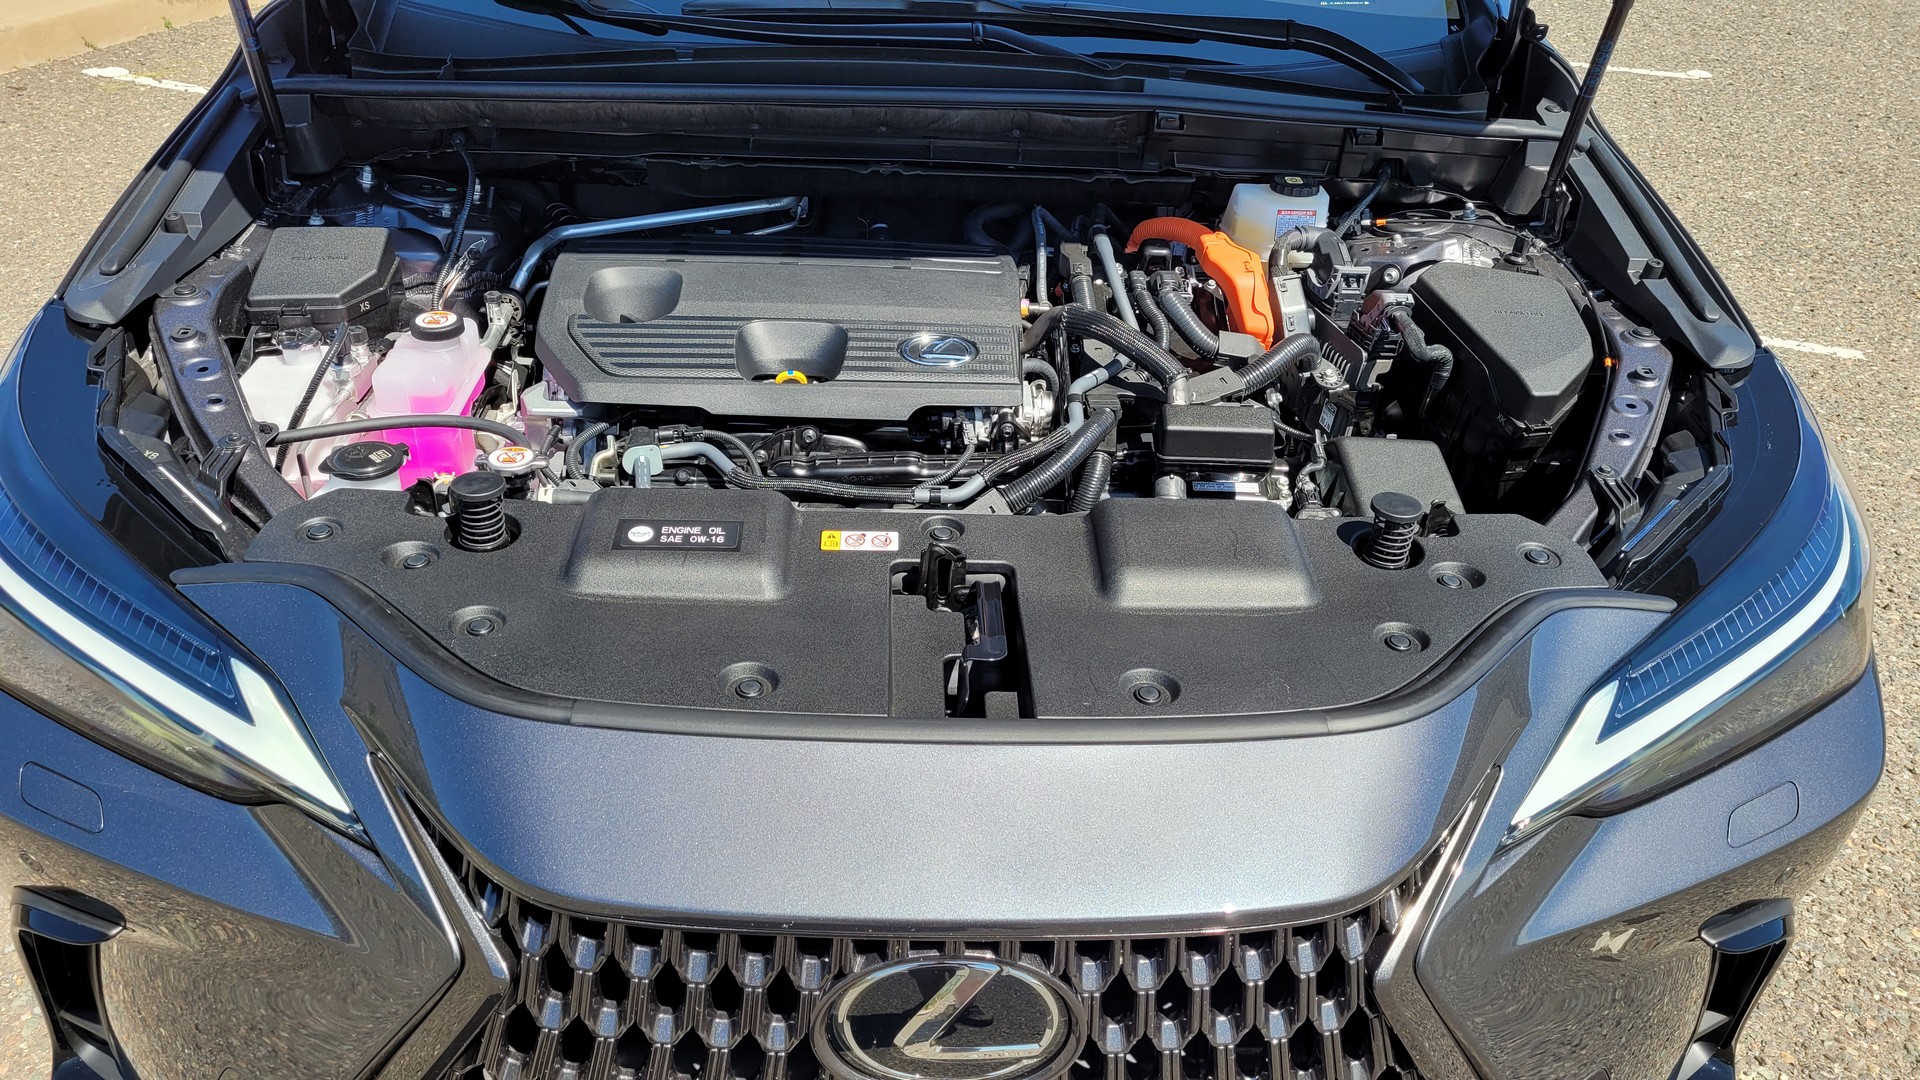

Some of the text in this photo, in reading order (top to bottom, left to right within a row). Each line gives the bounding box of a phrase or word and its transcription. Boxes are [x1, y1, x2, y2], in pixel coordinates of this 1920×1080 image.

[359, 301, 370, 312] XS
[661, 526, 726, 535] ENGINE OIL
[659, 535, 725, 544] SAE 0W-16
